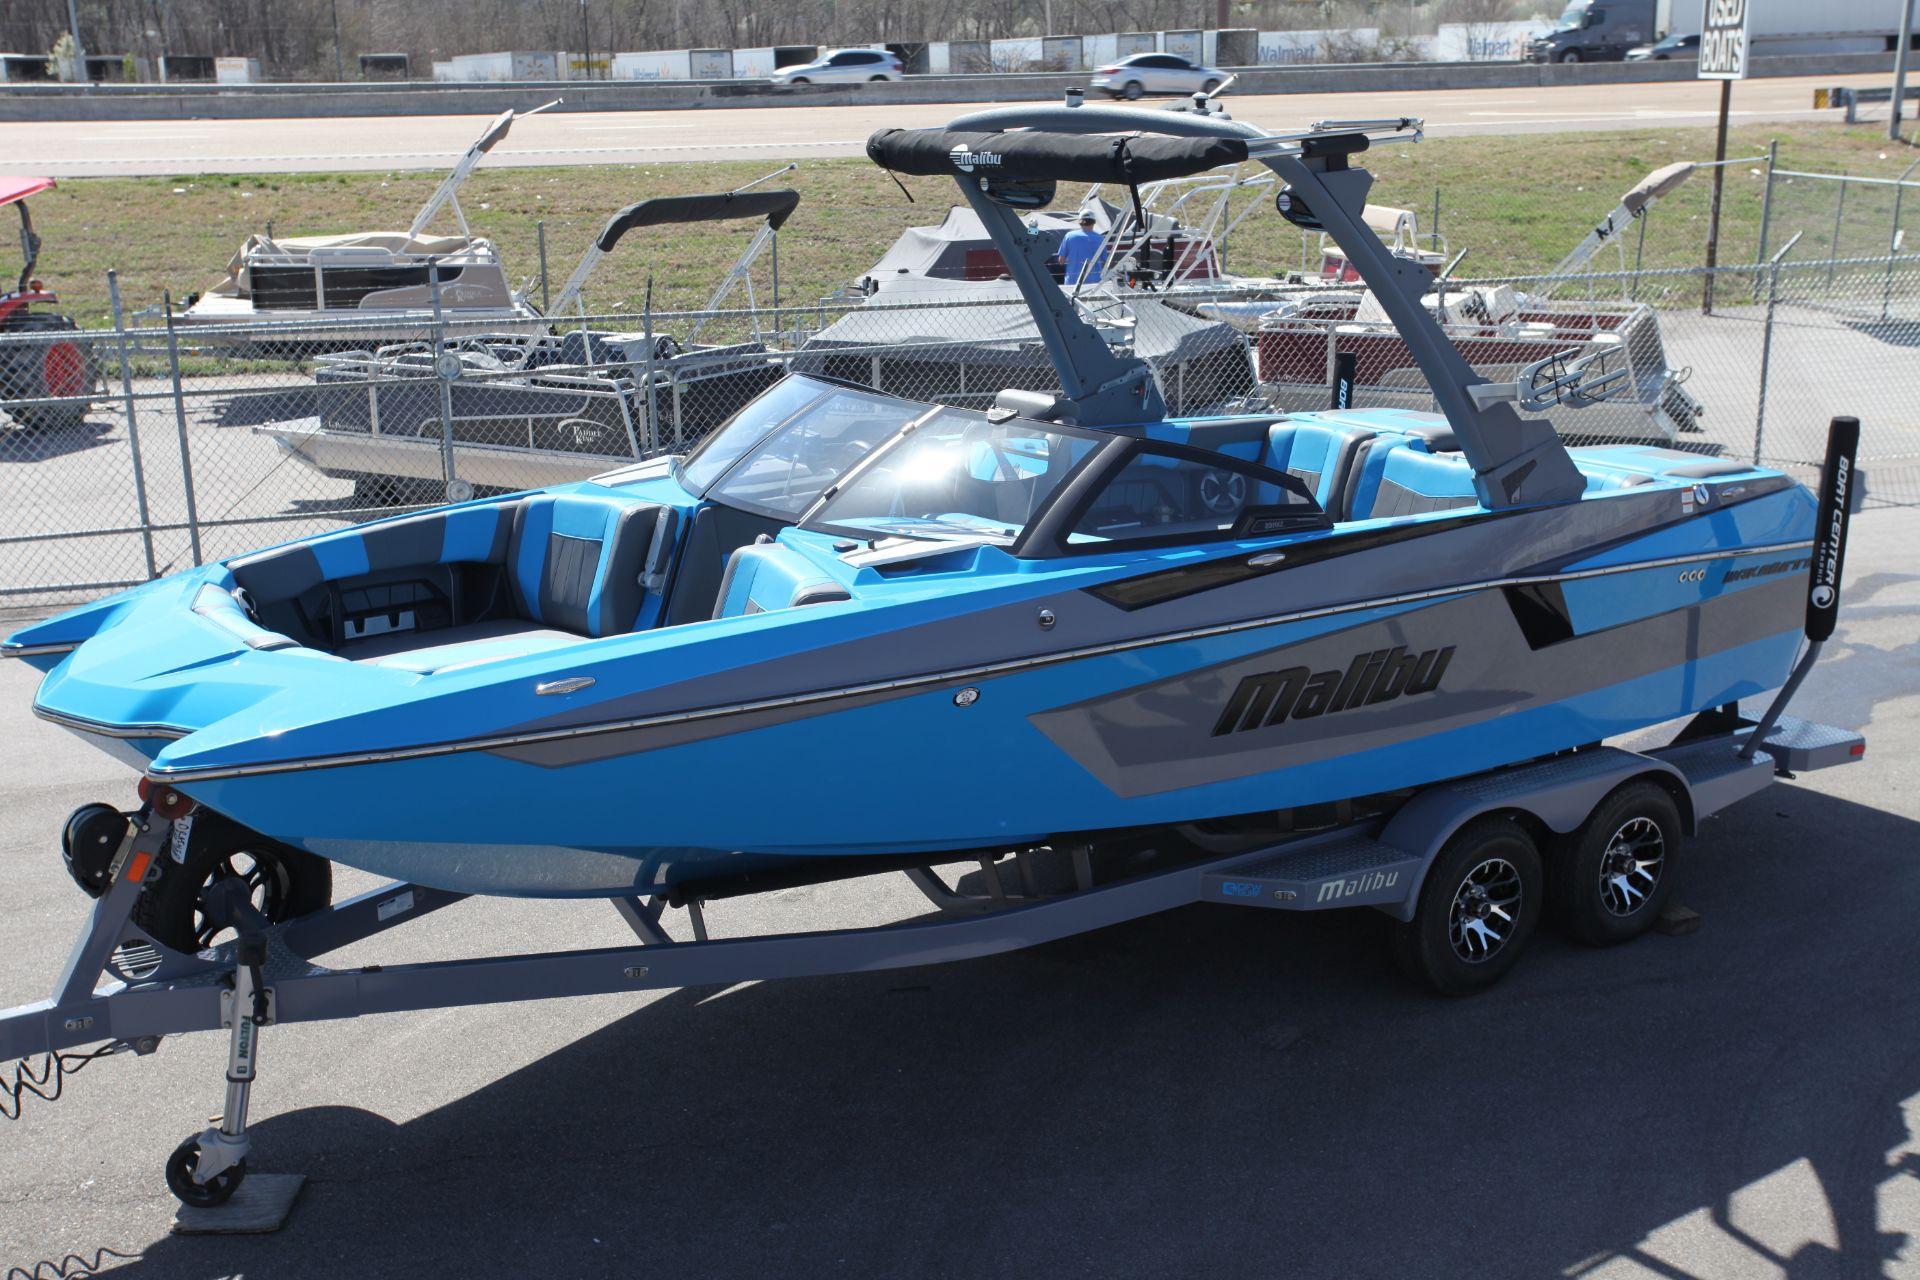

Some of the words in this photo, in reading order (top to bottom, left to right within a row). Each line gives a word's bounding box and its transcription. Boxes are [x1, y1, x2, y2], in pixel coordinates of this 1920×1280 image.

[1709, 0, 1742, 27] USED
[1701, 29, 1744, 72] BOATS
[1834, 455, 1849, 509] BOAT
[1825, 509, 1843, 586] CENTER
[238, 1015, 251, 1059] FULTON
